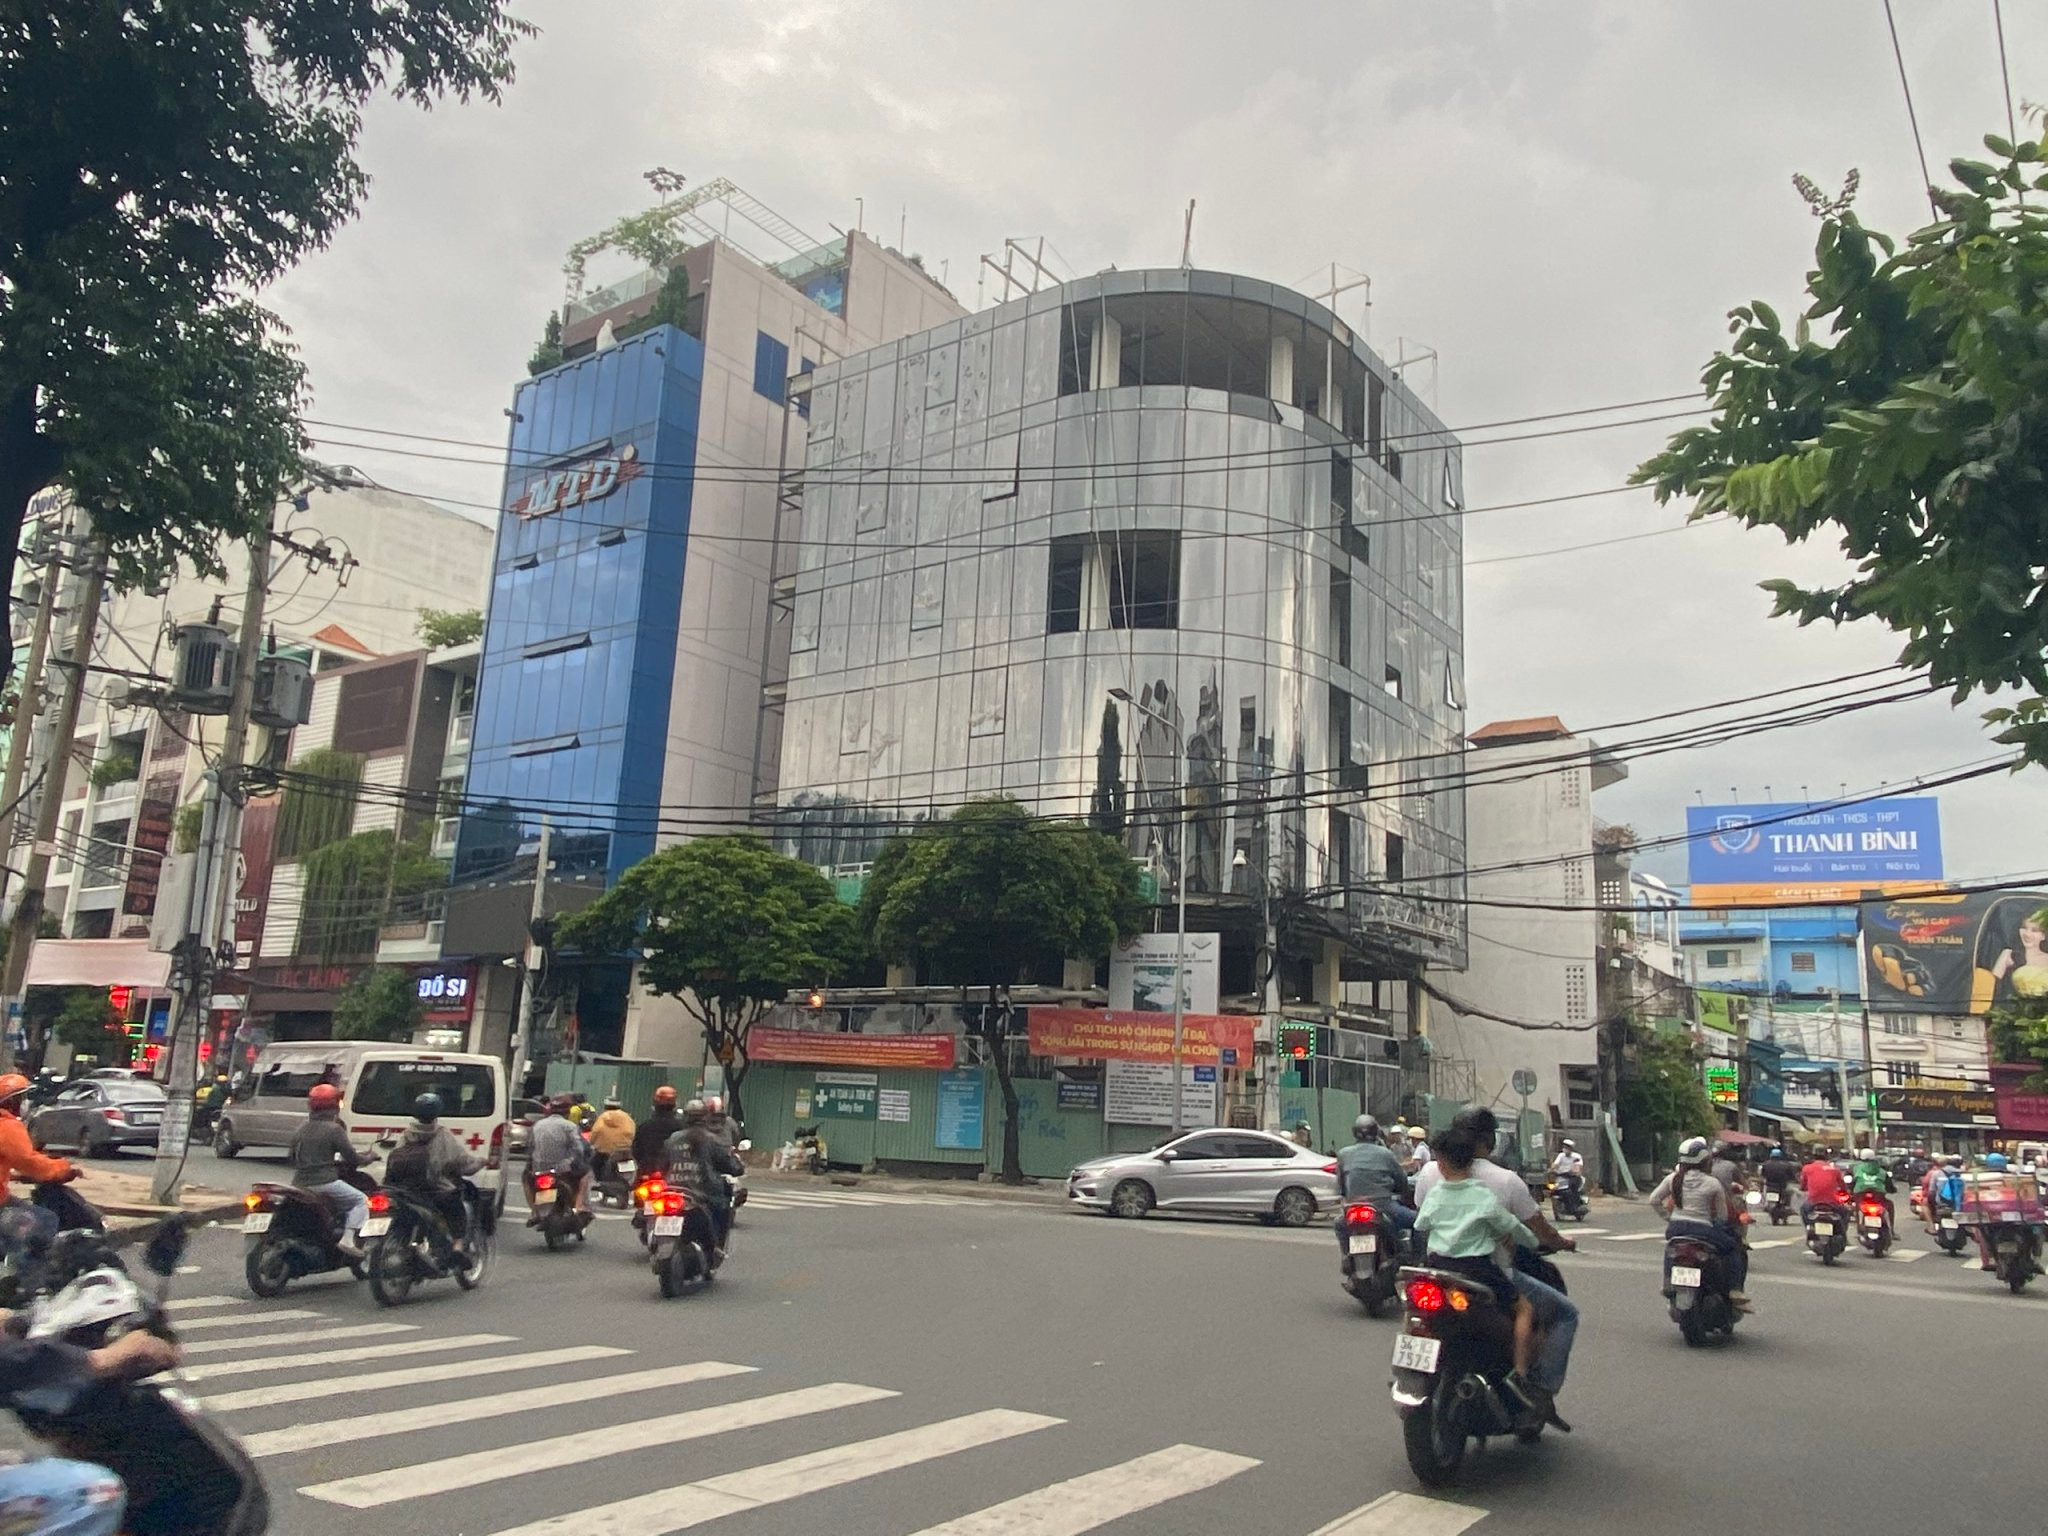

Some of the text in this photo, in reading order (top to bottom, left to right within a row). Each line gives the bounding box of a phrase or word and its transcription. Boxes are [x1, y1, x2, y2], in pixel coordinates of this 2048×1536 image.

[520, 457, 620, 520] MTD
[1843, 812, 1868, 823] THCS
[1876, 811, 1899, 822] THPT
[1769, 827, 1918, 854] THANH BÌNH
[446, 978, 467, 997] SI
[1074, 1023, 1093, 1034] CHỦ
[1095, 1023, 1117, 1036] TỊCH
[1120, 1024, 1132, 1036] HỒ
[1135, 1023, 1151, 1037] CHÍ
[1087, 1038, 1118, 1049] TRONG
[1120, 1040, 1132, 1052] SỰ
[1133, 1041, 1170, 1054] NGHIỆP
